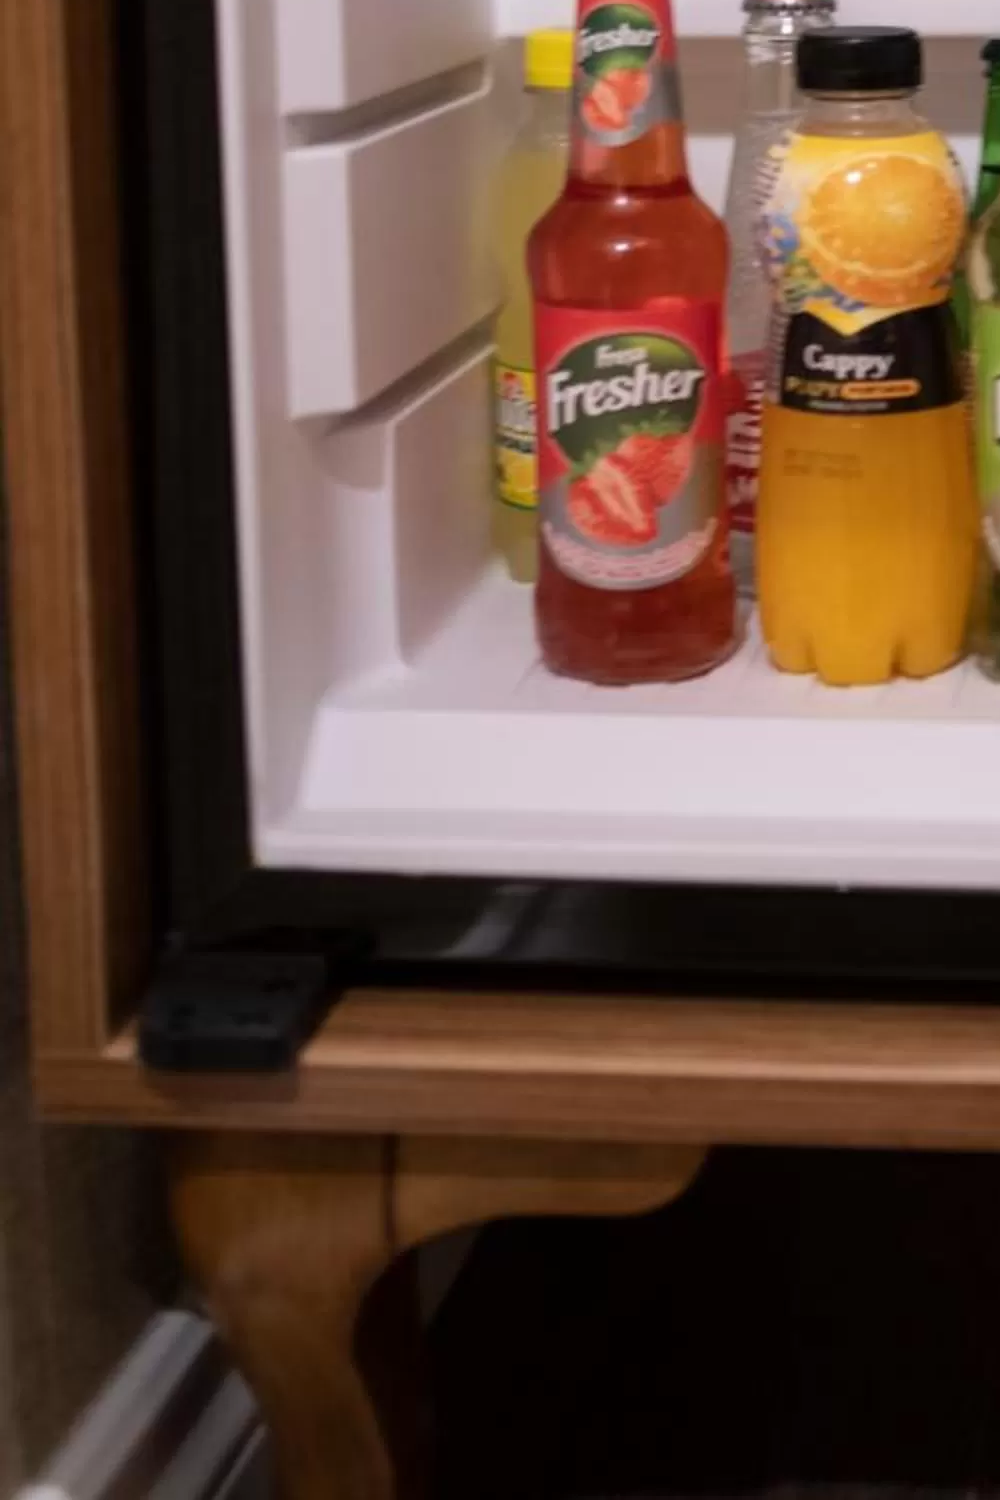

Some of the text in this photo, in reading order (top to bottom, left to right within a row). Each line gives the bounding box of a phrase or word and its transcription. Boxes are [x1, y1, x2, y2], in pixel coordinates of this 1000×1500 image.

[580, 22, 660, 61] Fresher
[803, 344, 895, 379] Cappy
[548, 362, 705, 432] Fresher
